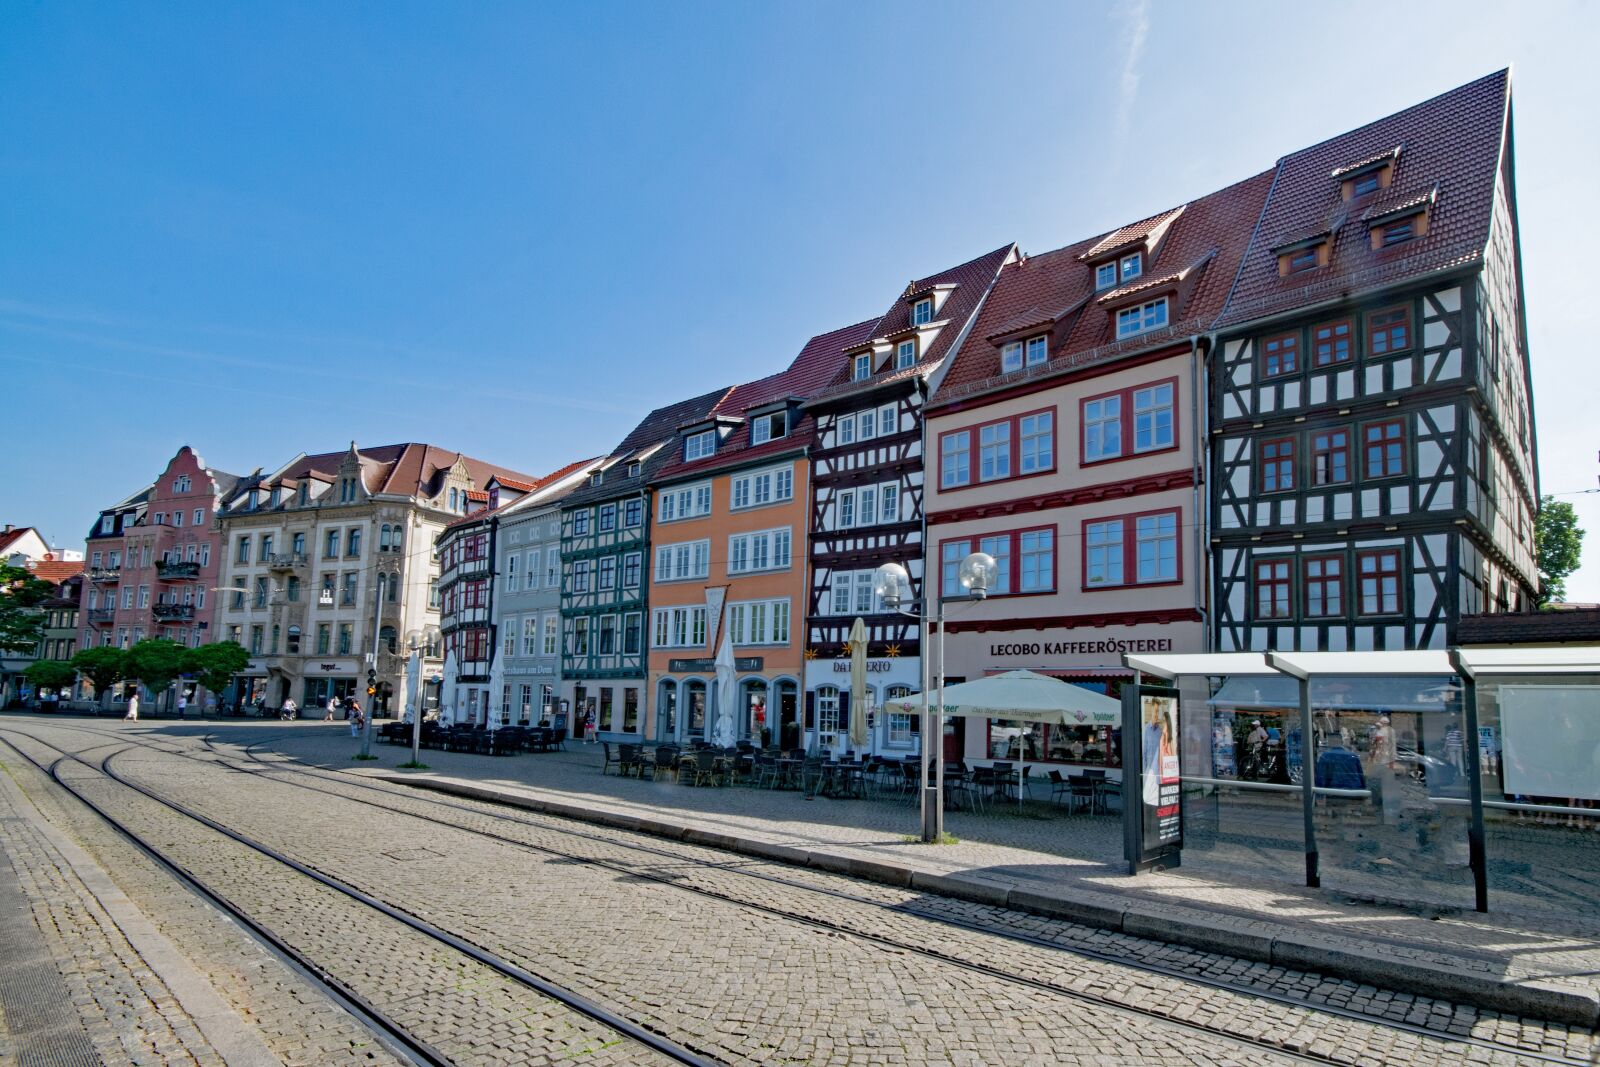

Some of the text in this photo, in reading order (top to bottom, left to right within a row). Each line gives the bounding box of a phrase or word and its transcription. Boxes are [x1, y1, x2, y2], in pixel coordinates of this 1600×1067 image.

[990, 637, 1172, 656] LECOBO KAFFEERÖSTEREI
[833, 661, 846, 672] DA
